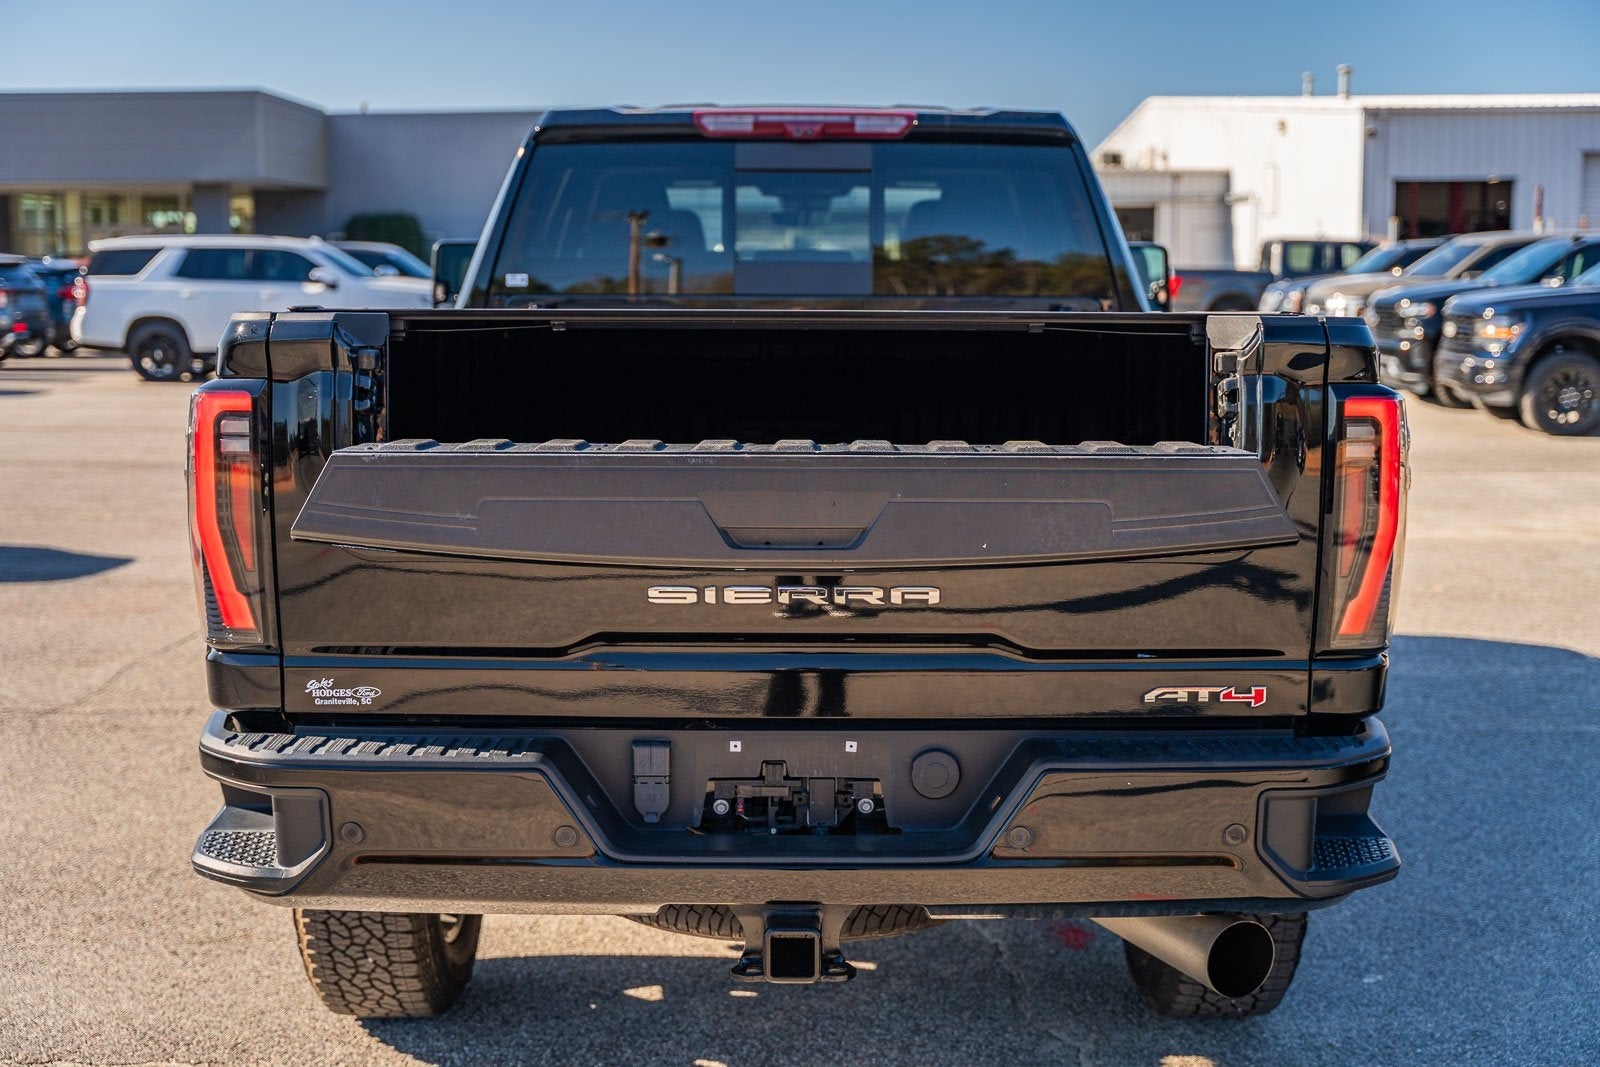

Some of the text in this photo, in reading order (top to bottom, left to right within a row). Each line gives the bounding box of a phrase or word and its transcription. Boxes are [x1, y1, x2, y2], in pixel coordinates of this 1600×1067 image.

[647, 586, 940, 605] SIERRA
[311, 688, 352, 697] HODGES
[1144, 686, 1267, 707] AT4
[314, 697, 372, 706] Graniteville, SC
